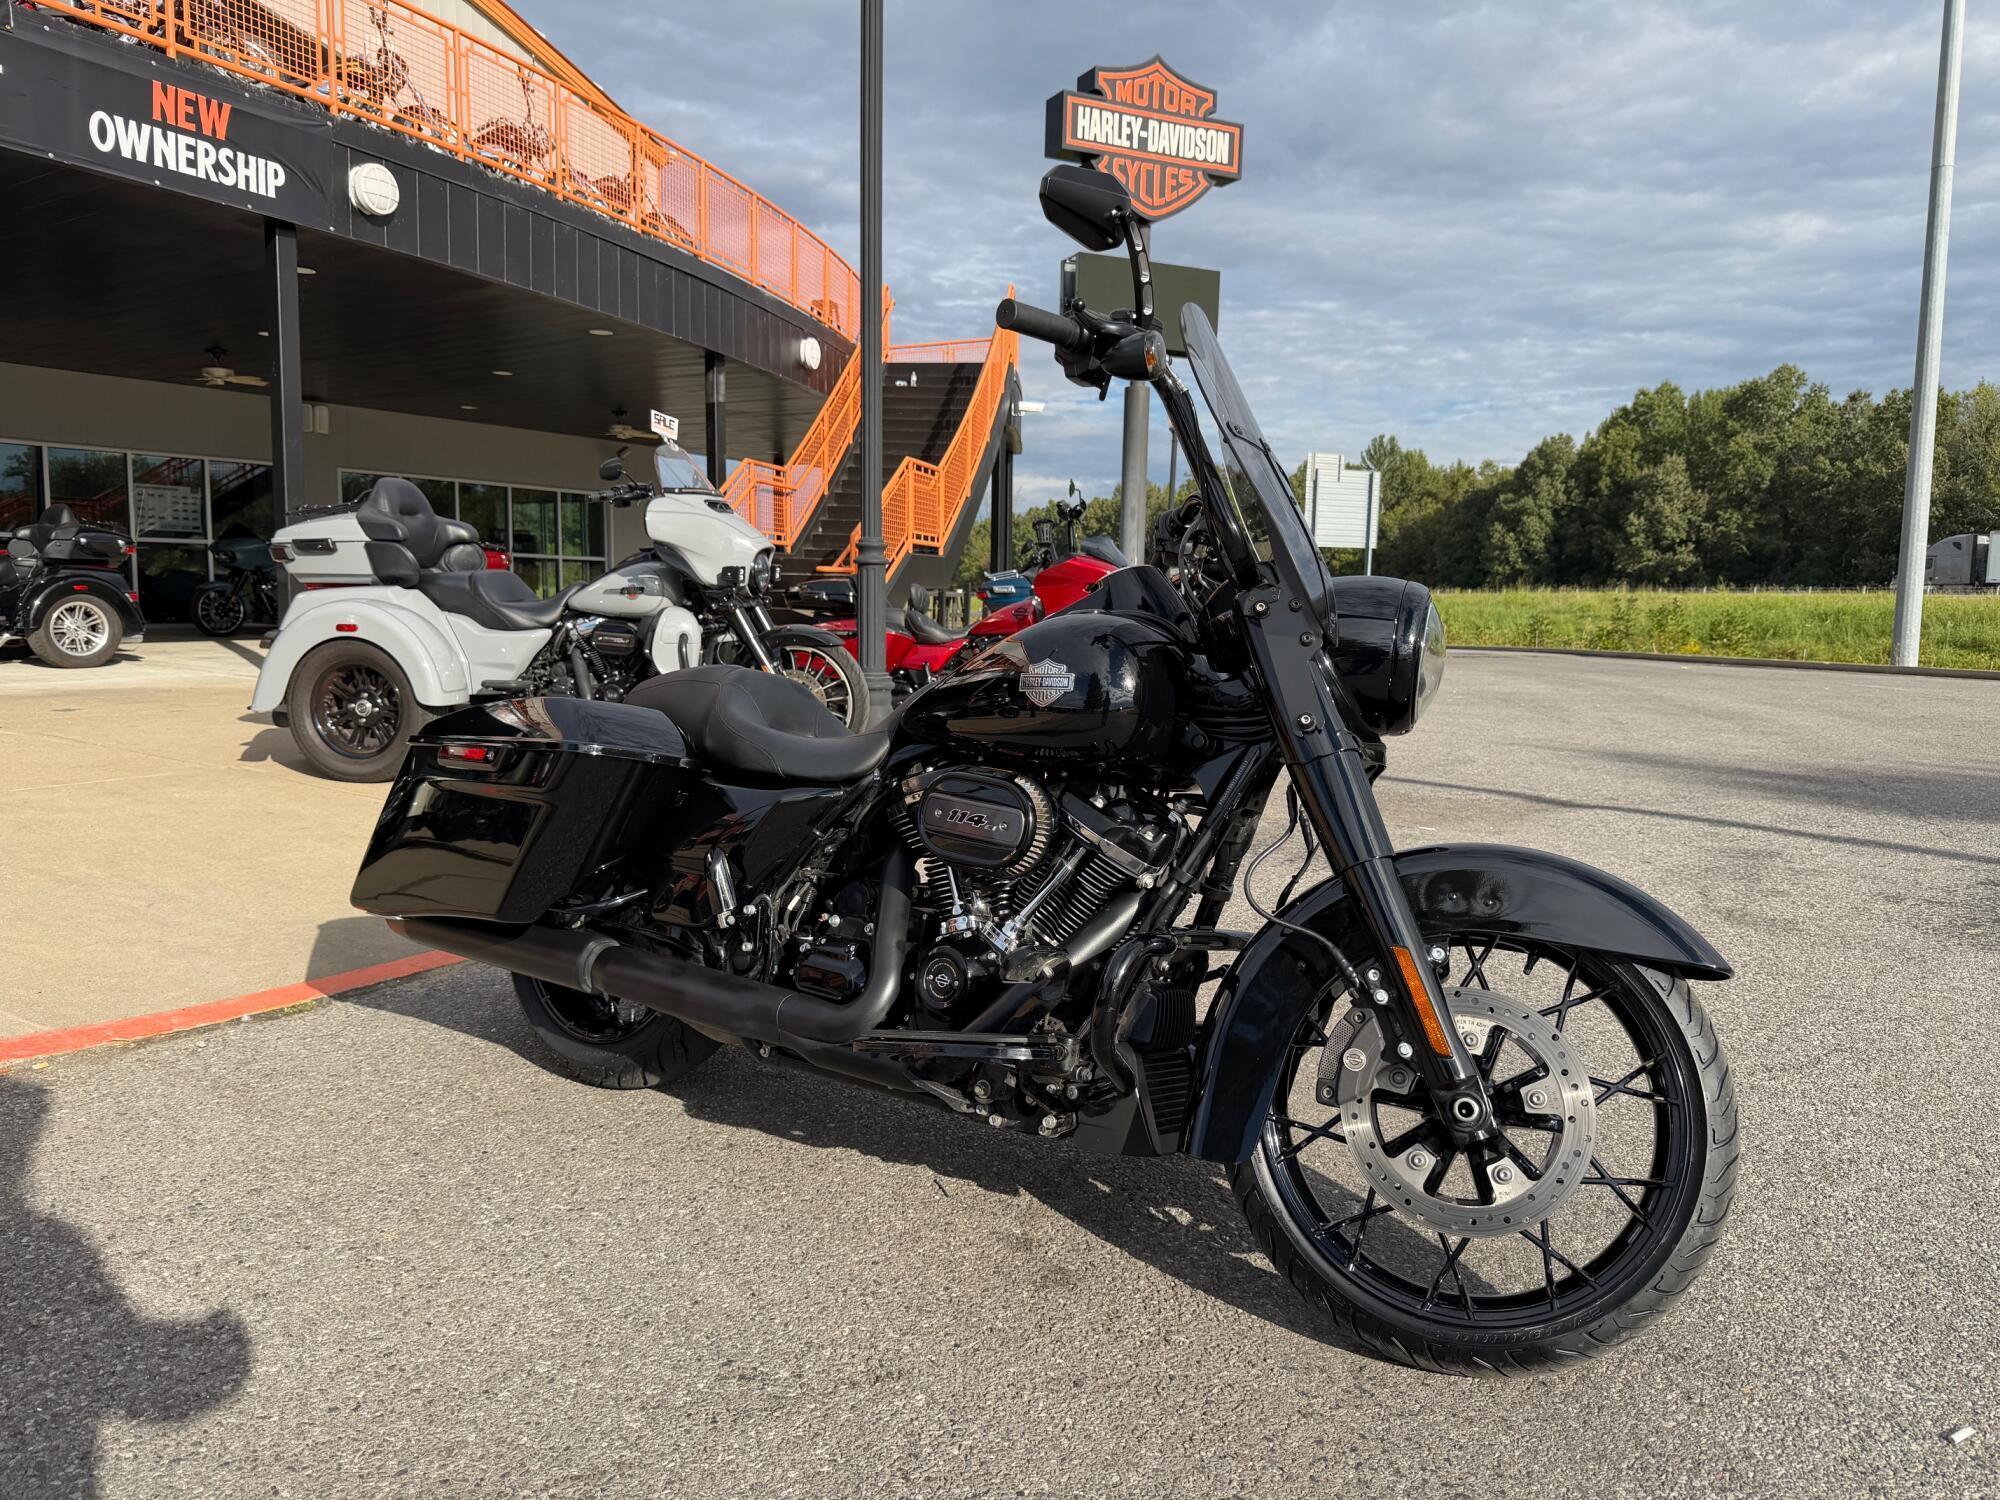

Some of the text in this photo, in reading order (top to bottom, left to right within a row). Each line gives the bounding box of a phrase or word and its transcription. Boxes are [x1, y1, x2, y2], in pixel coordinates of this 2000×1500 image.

[152, 79, 232, 141] NEW
[1116, 73, 1196, 116] MOTOR
[88, 110, 286, 198] OWNERSHIP
[1076, 105, 1230, 164] HARLEY-DAVIDSON
[1113, 157, 1196, 206] CYCLES
[654, 413, 675, 430] SALE
[947, 808, 988, 827] 114
